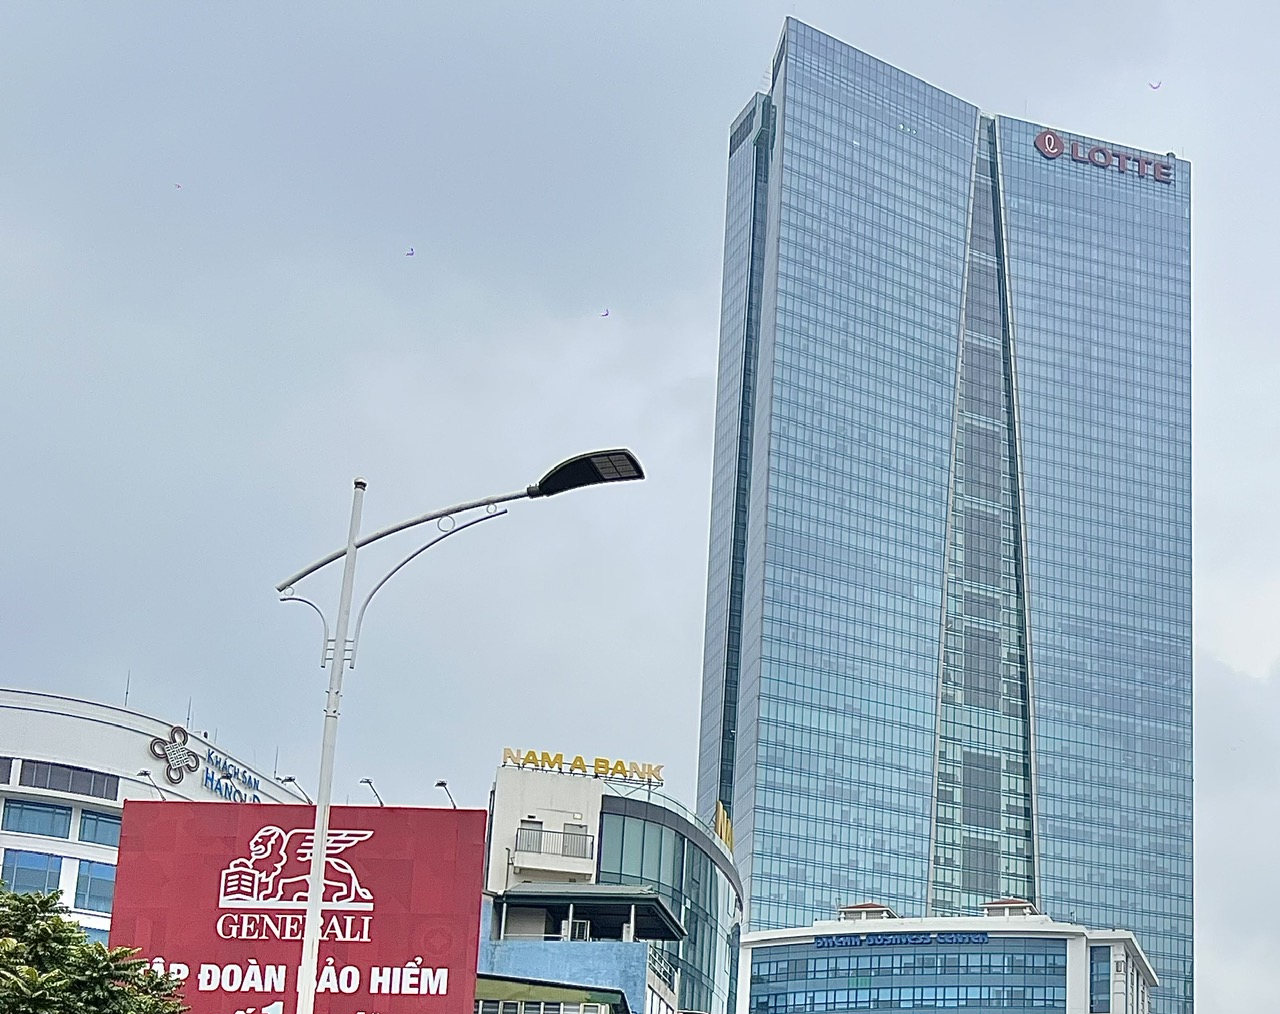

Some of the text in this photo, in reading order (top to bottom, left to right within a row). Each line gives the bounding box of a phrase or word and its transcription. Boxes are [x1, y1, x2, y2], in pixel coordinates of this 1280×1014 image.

[1071, 142, 1174, 184] LOTTE
[503, 748, 664, 781] NAM A BANK
[197, 958, 287, 992] ĐOÀN
[369, 957, 449, 995] HIỂM
